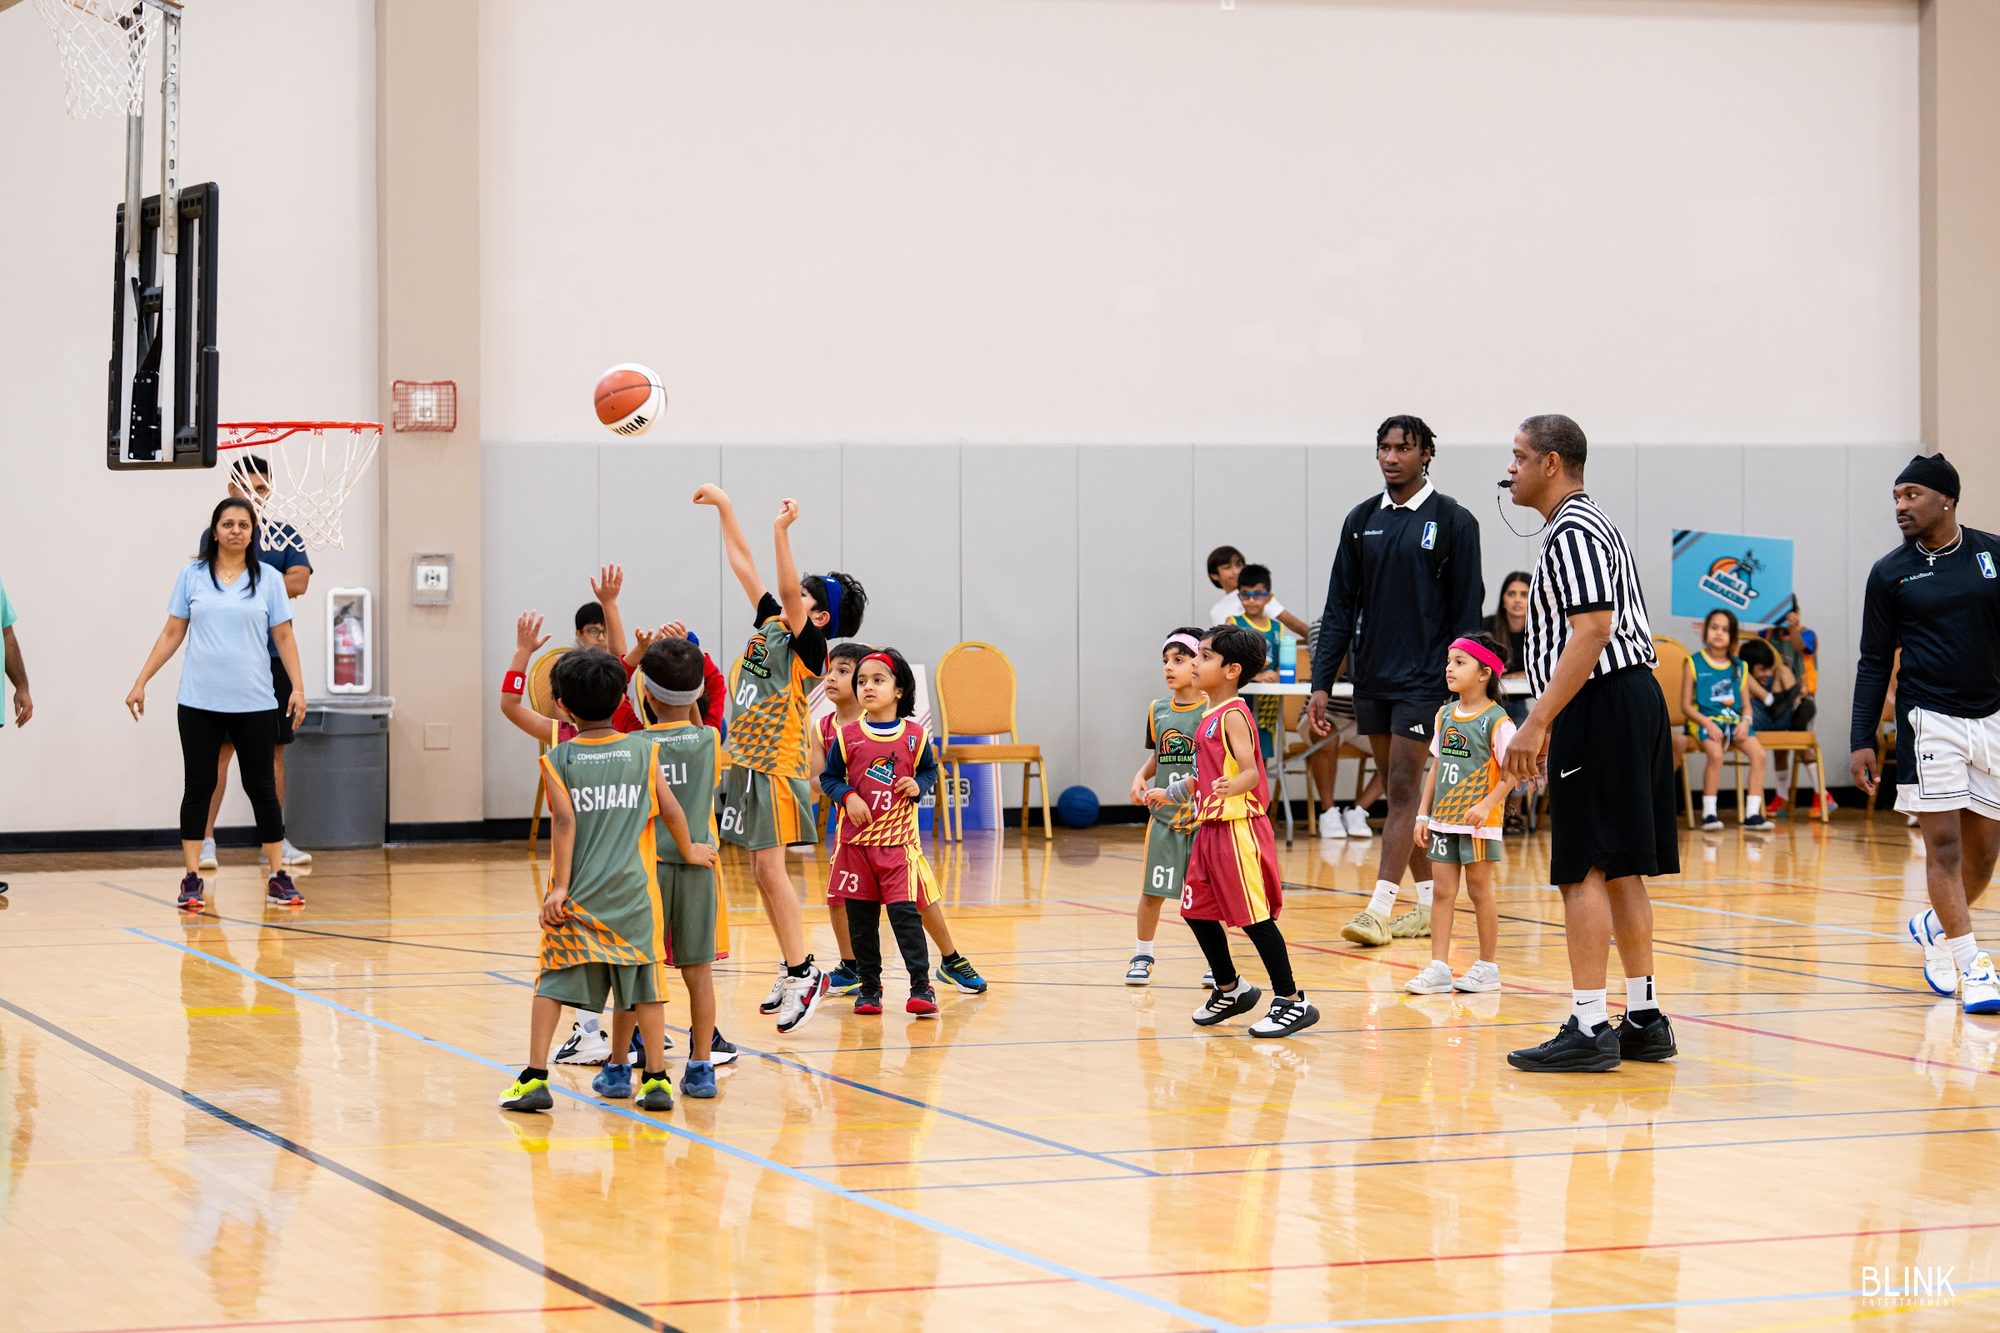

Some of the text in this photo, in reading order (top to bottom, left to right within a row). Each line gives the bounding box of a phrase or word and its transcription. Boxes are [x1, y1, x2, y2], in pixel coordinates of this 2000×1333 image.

[736, 679, 758, 710] 60
[577, 750, 632, 761] COMMUNITY FOCUS
[1159, 755, 1193, 763] GREEN GIAN
[1441, 762, 1460, 785] 76
[871, 790, 893, 811] 73
[1430, 833, 1448, 856] 76
[838, 870, 859, 893] 73
[1152, 865, 1175, 890] 61
